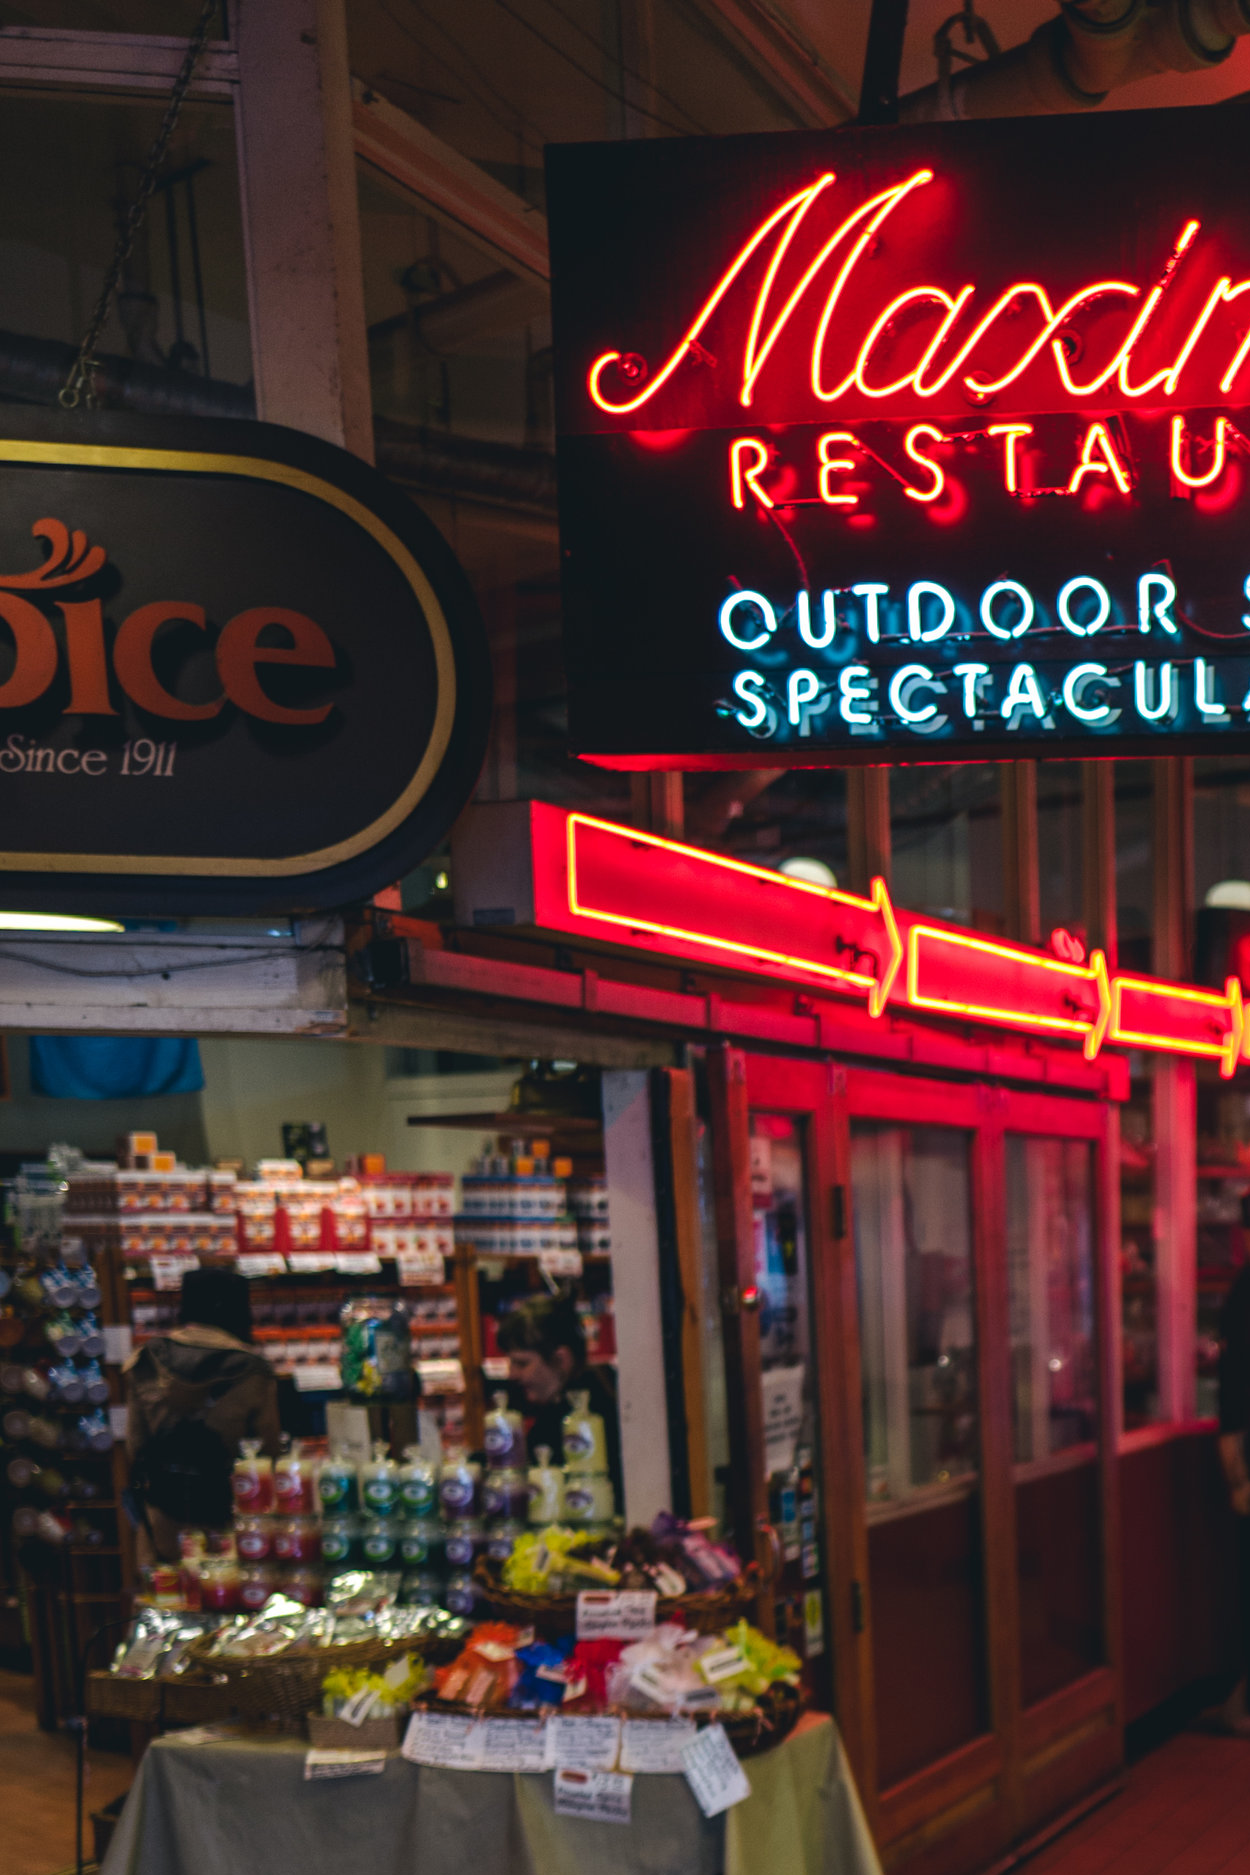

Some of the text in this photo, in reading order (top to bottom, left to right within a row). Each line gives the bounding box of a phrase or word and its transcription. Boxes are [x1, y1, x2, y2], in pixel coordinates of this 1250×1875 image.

[718, 571, 1180, 652] OUTDOOR
[0, 734, 176, 777] Since 1911
